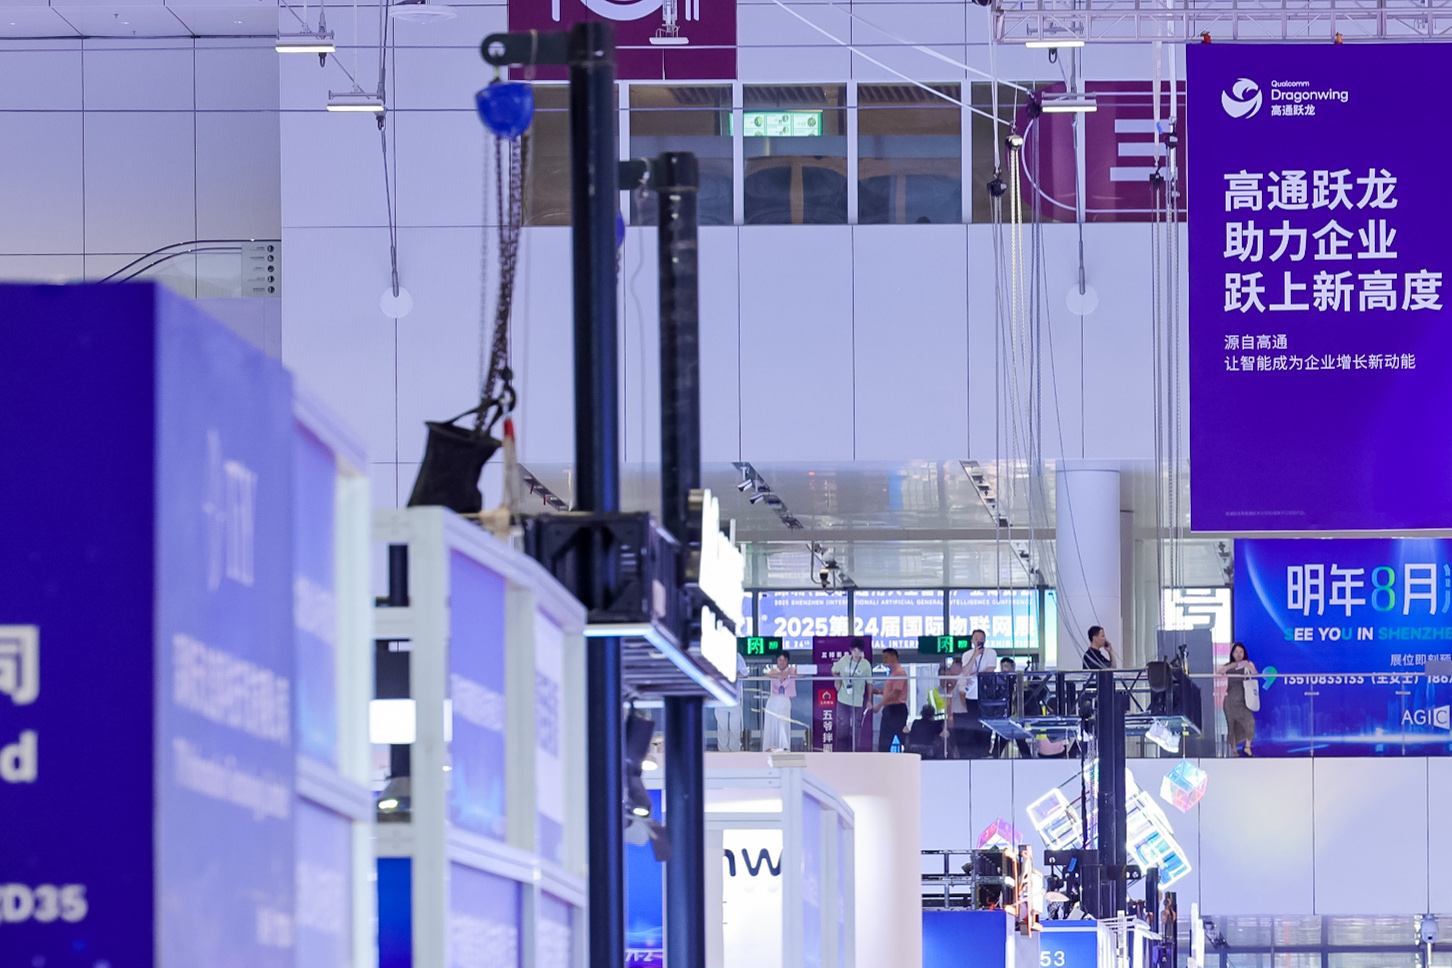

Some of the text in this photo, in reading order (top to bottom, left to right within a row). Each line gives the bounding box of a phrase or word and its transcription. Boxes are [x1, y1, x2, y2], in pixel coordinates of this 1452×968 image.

[1271, 89, 1349, 103] Dragonwing
[1271, 105, 1316, 116] 高通跃龙
[1223, 168, 1399, 212] 高通跃龙
[1223, 219, 1399, 263] 助力企业
[1223, 269, 1444, 314] 跃上新高度
[1224, 334, 1288, 351] 源自高通
[1224, 353, 1417, 372] 让智能成为企业增长新动能
[1284, 627, 1314, 642] SEE
[1318, 626, 1353, 642] YOU
[1357, 626, 1374, 641] IN
[1401, 706, 1449, 730] AGIC
